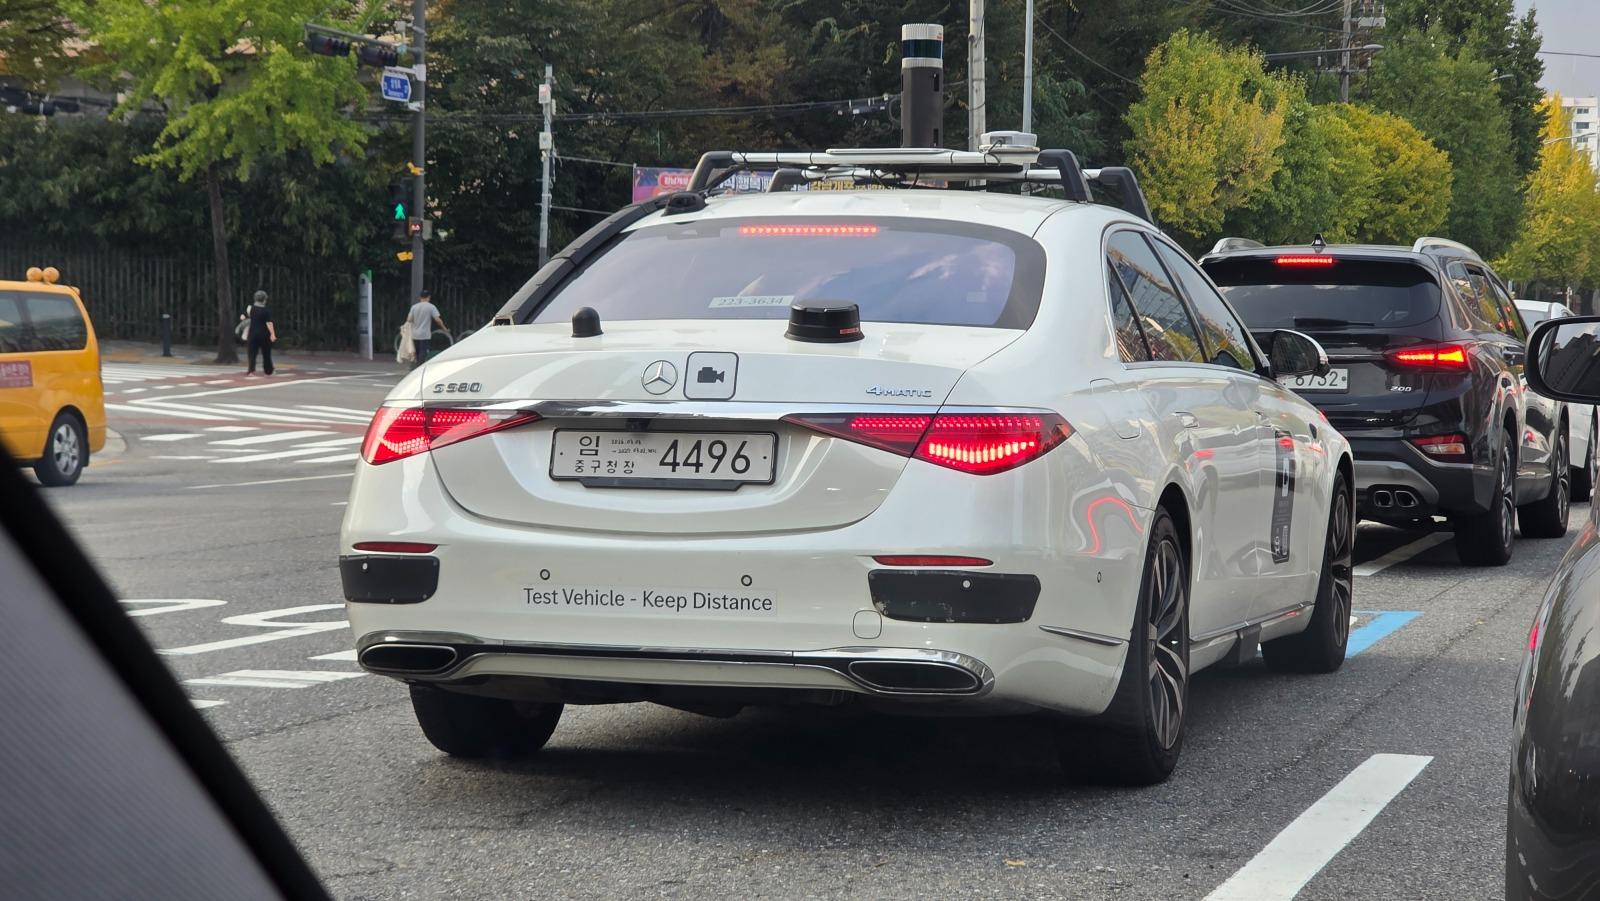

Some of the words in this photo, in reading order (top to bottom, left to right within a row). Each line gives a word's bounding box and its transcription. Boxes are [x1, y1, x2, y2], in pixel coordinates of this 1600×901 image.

[574, 459, 635, 474] 중구청장
[579, 435, 600, 456] 임
[659, 439, 751, 474] 4496
[523, 587, 559, 605] Test
[562, 588, 625, 607] Vehicle
[642, 590, 688, 612] Keep
[693, 592, 773, 611] Distance
